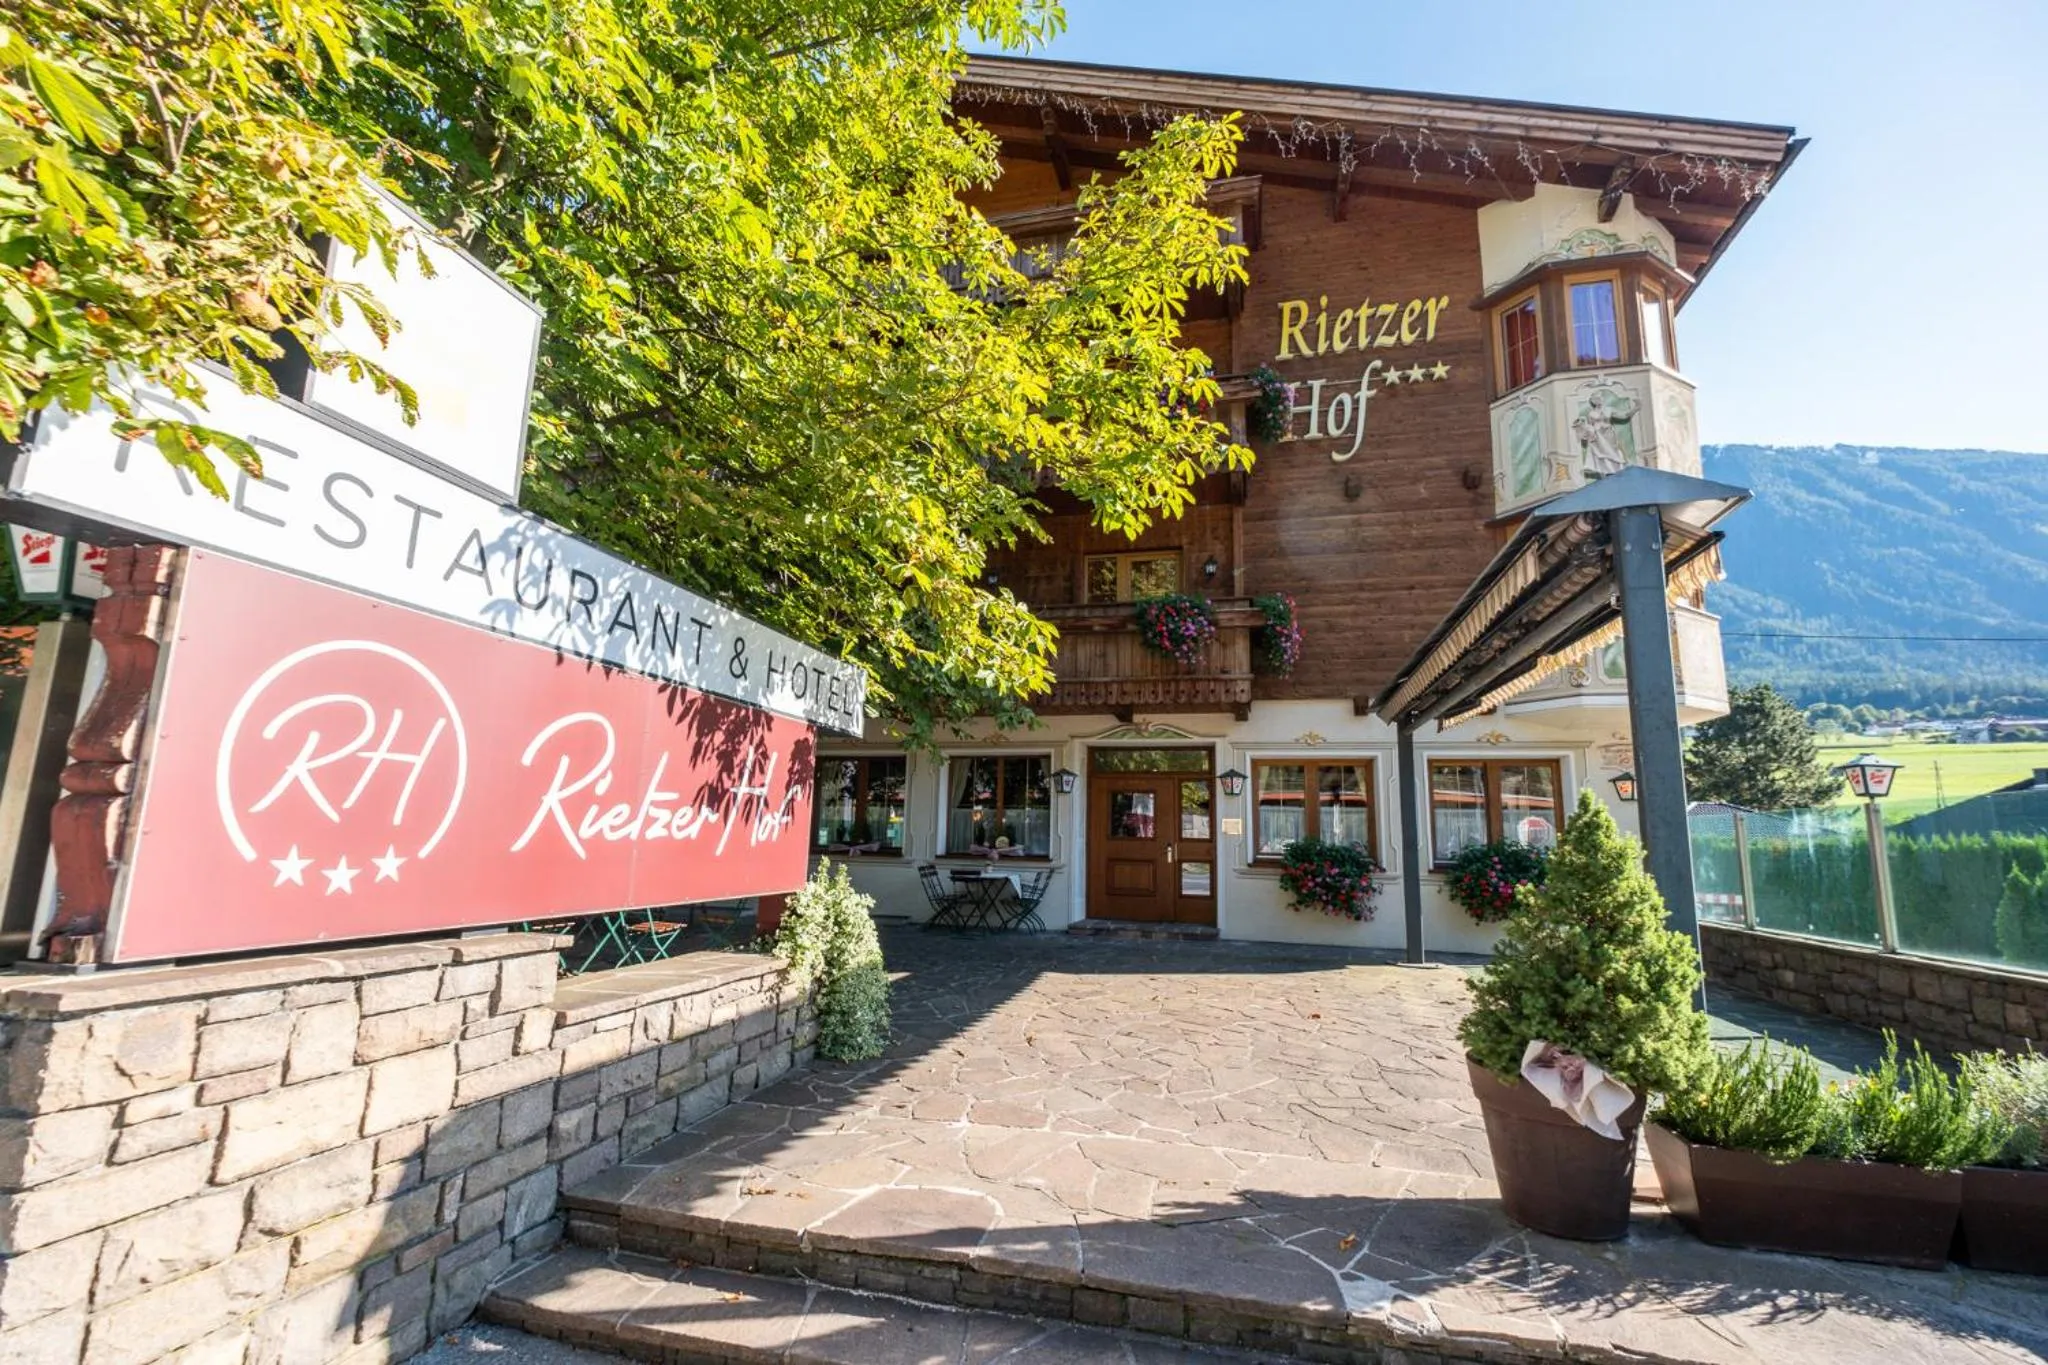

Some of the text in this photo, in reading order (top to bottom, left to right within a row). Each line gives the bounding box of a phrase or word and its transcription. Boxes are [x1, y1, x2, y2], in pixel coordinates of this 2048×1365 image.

[1275, 294, 1450, 361] Rietzer
[1277, 359, 1382, 462] Hof
[113, 387, 854, 717] RESTAURANT & HOTEL
[248, 693, 447, 826] RH
[510, 711, 804, 860] Rietzer Hof
